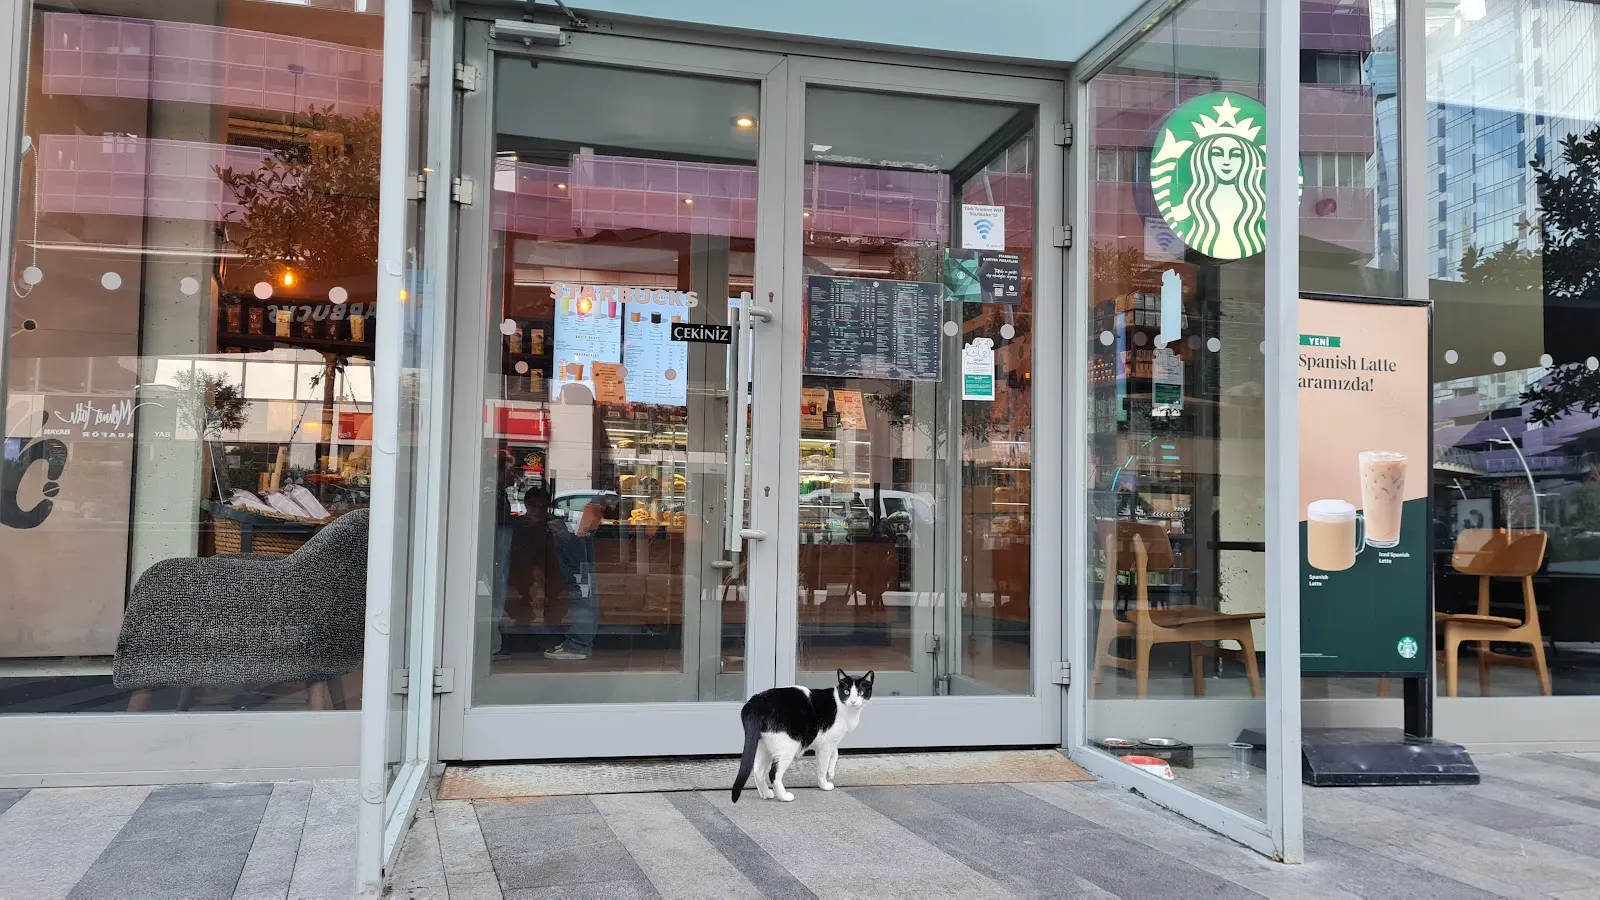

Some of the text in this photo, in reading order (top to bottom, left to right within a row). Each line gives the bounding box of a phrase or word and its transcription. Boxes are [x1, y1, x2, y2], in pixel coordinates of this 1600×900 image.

[549, 282, 699, 308] STARBUCKS
[674, 324, 729, 341] ÇEKİNİZ
[1308, 337, 1330, 346] YENİ
[1298, 353, 1397, 372] Spanish Latte
[1298, 376, 1375, 392] aramızda!
